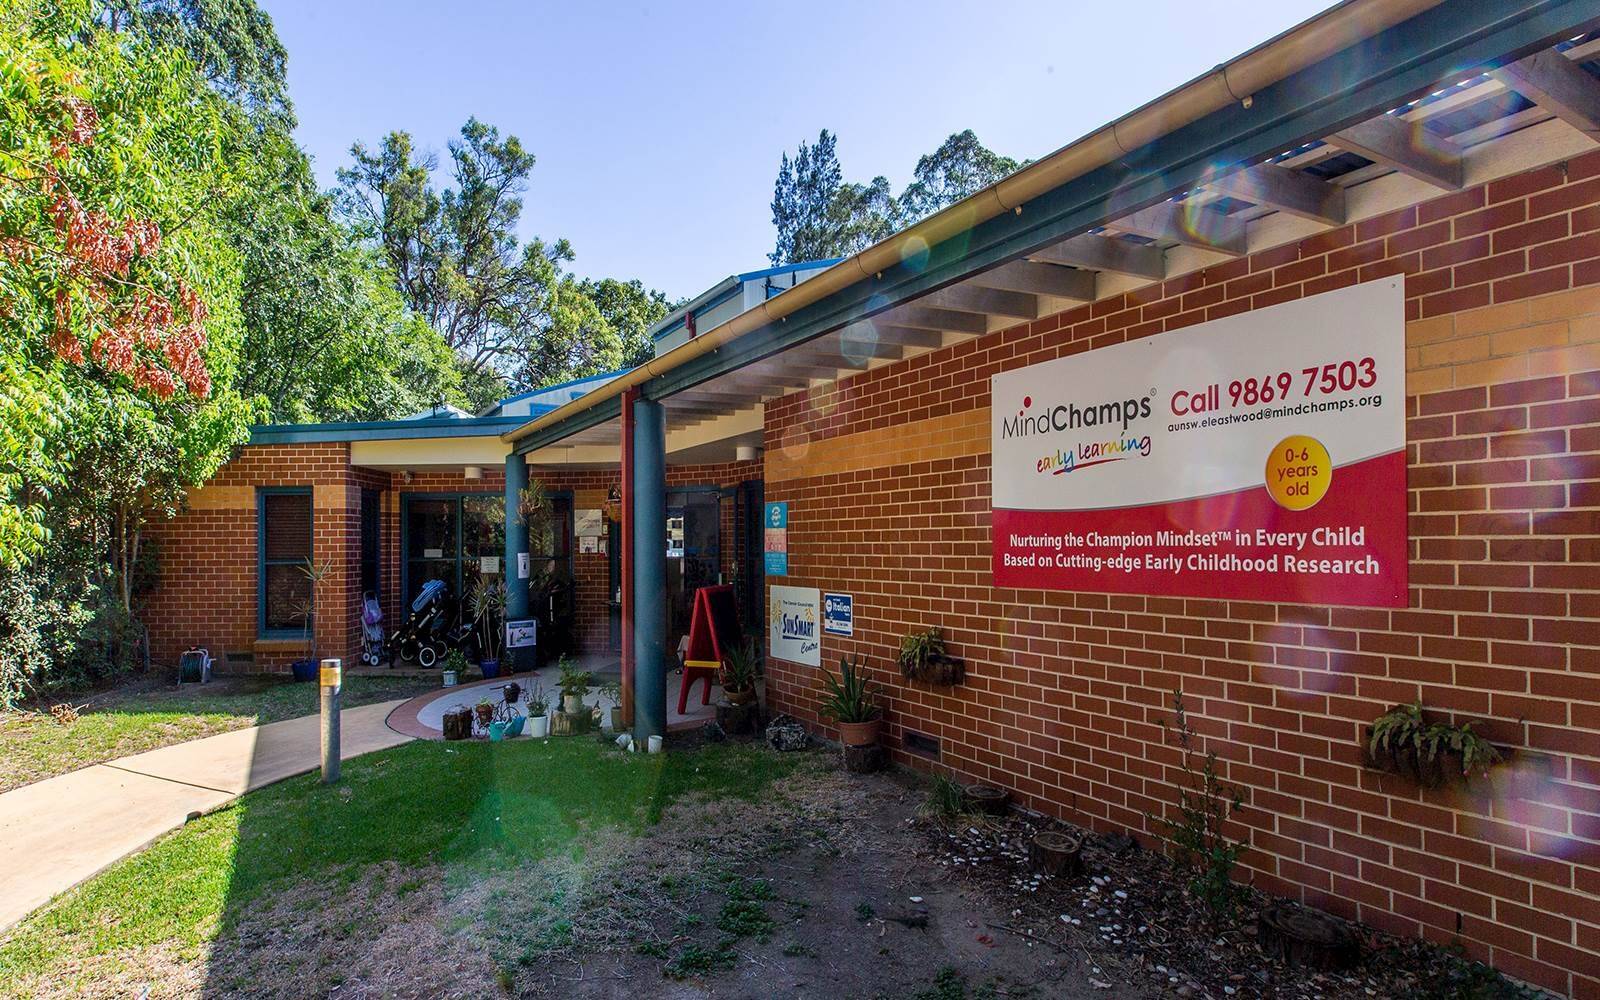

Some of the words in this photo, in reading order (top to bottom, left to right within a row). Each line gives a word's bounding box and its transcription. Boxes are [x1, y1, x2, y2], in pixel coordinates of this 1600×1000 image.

[1171, 384, 1219, 416] Call
[1228, 372, 1292, 407] 9869
[1302, 357, 1377, 397] 7503
[1168, 394, 1382, 432] aunsw.eleastwood@mindchamps.org
[1037, 450, 1074, 472] early
[1078, 431, 1151, 460] learning
[1285, 447, 1308, 462] 0-6
[1277, 465, 1318, 481] years
[1286, 481, 1309, 496] old
[1010, 533, 1061, 550] Nurturing
[1064, 532, 1084, 547] the
[1086, 531, 1153, 550] Champion
[1235, 529, 1251, 546] in
[1256, 528, 1307, 551] Every
[1311, 526, 1365, 546] Child
[1004, 553, 1035, 567] Based
[1038, 556, 1053, 568] on
[1055, 553, 1141, 573] Cutting-edge
[1145, 553, 1183, 574] Early
[1187, 553, 1278, 572] Childhood
[1284, 554, 1380, 574] Research
[833, 602, 850, 612] Italian
[800, 642, 818, 654] Centre
